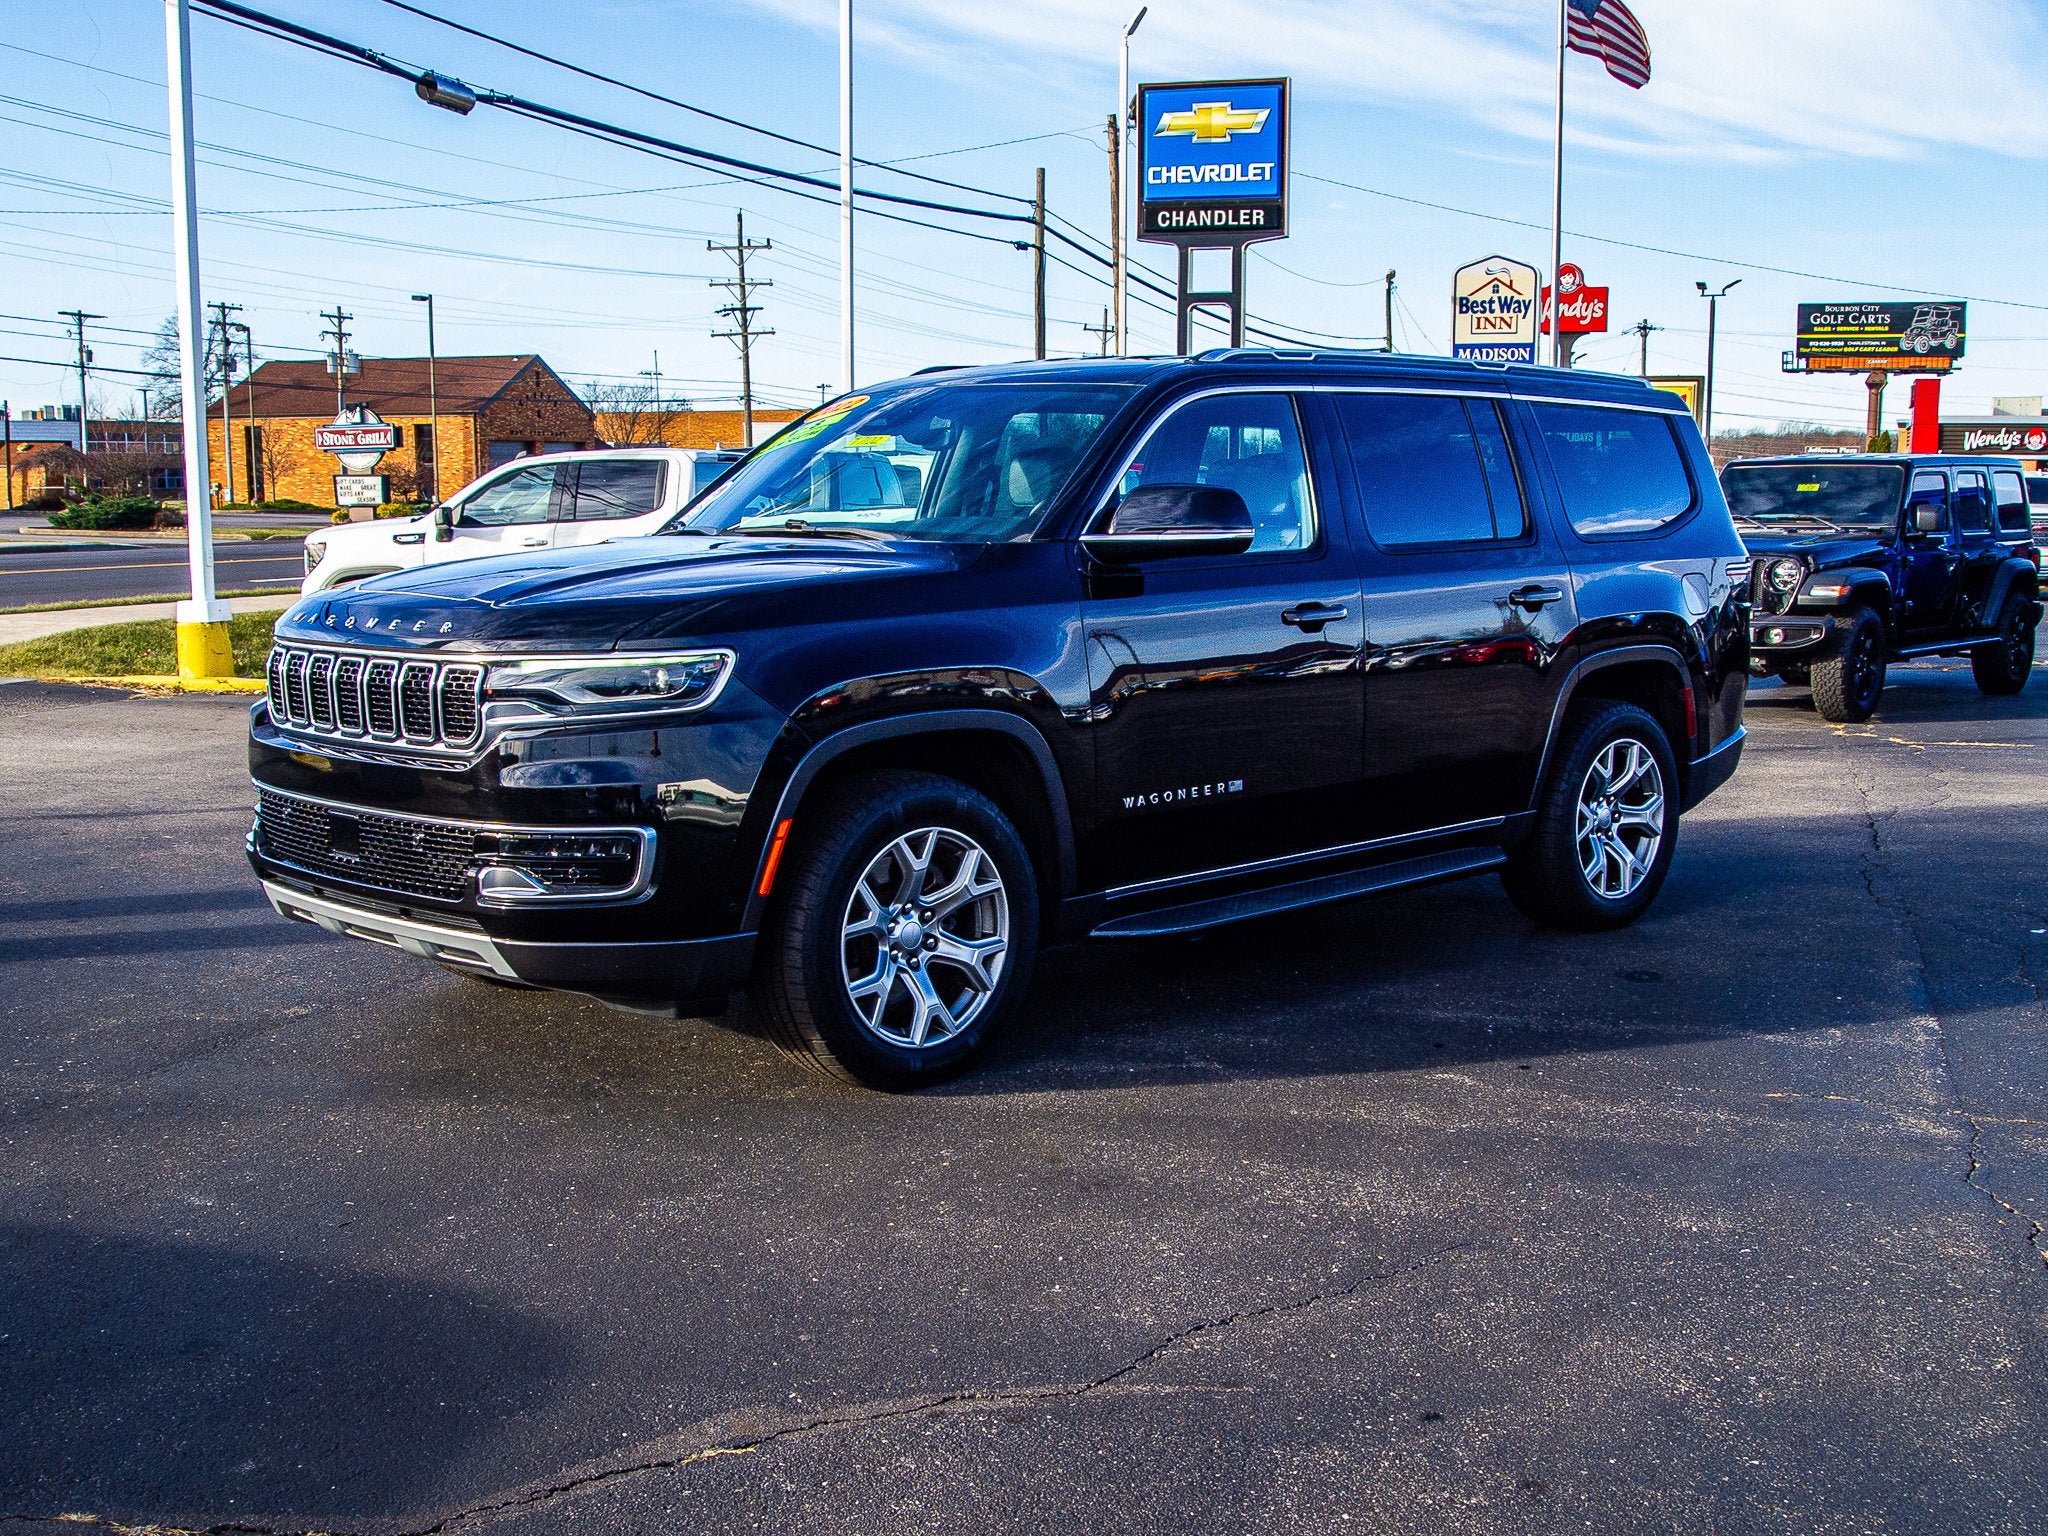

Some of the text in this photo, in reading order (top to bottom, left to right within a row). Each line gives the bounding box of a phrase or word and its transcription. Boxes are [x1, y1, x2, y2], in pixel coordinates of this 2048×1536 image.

[1148, 162, 1275, 184] CHEVROLET
[1157, 209, 1265, 227] CHANDLER
[1458, 296, 1532, 319] Best Way
[1541, 293, 1604, 325] ndy's
[1475, 316, 1514, 330] INN
[1810, 312, 1891, 325] GOLF CARTS
[1458, 347, 1531, 361] MADISON
[323, 431, 387, 446] STONE GRILL
[1964, 427, 2022, 450] Wendy's
[292, 613, 454, 634] WAGONEER
[1123, 782, 1225, 808] WAGONEER
